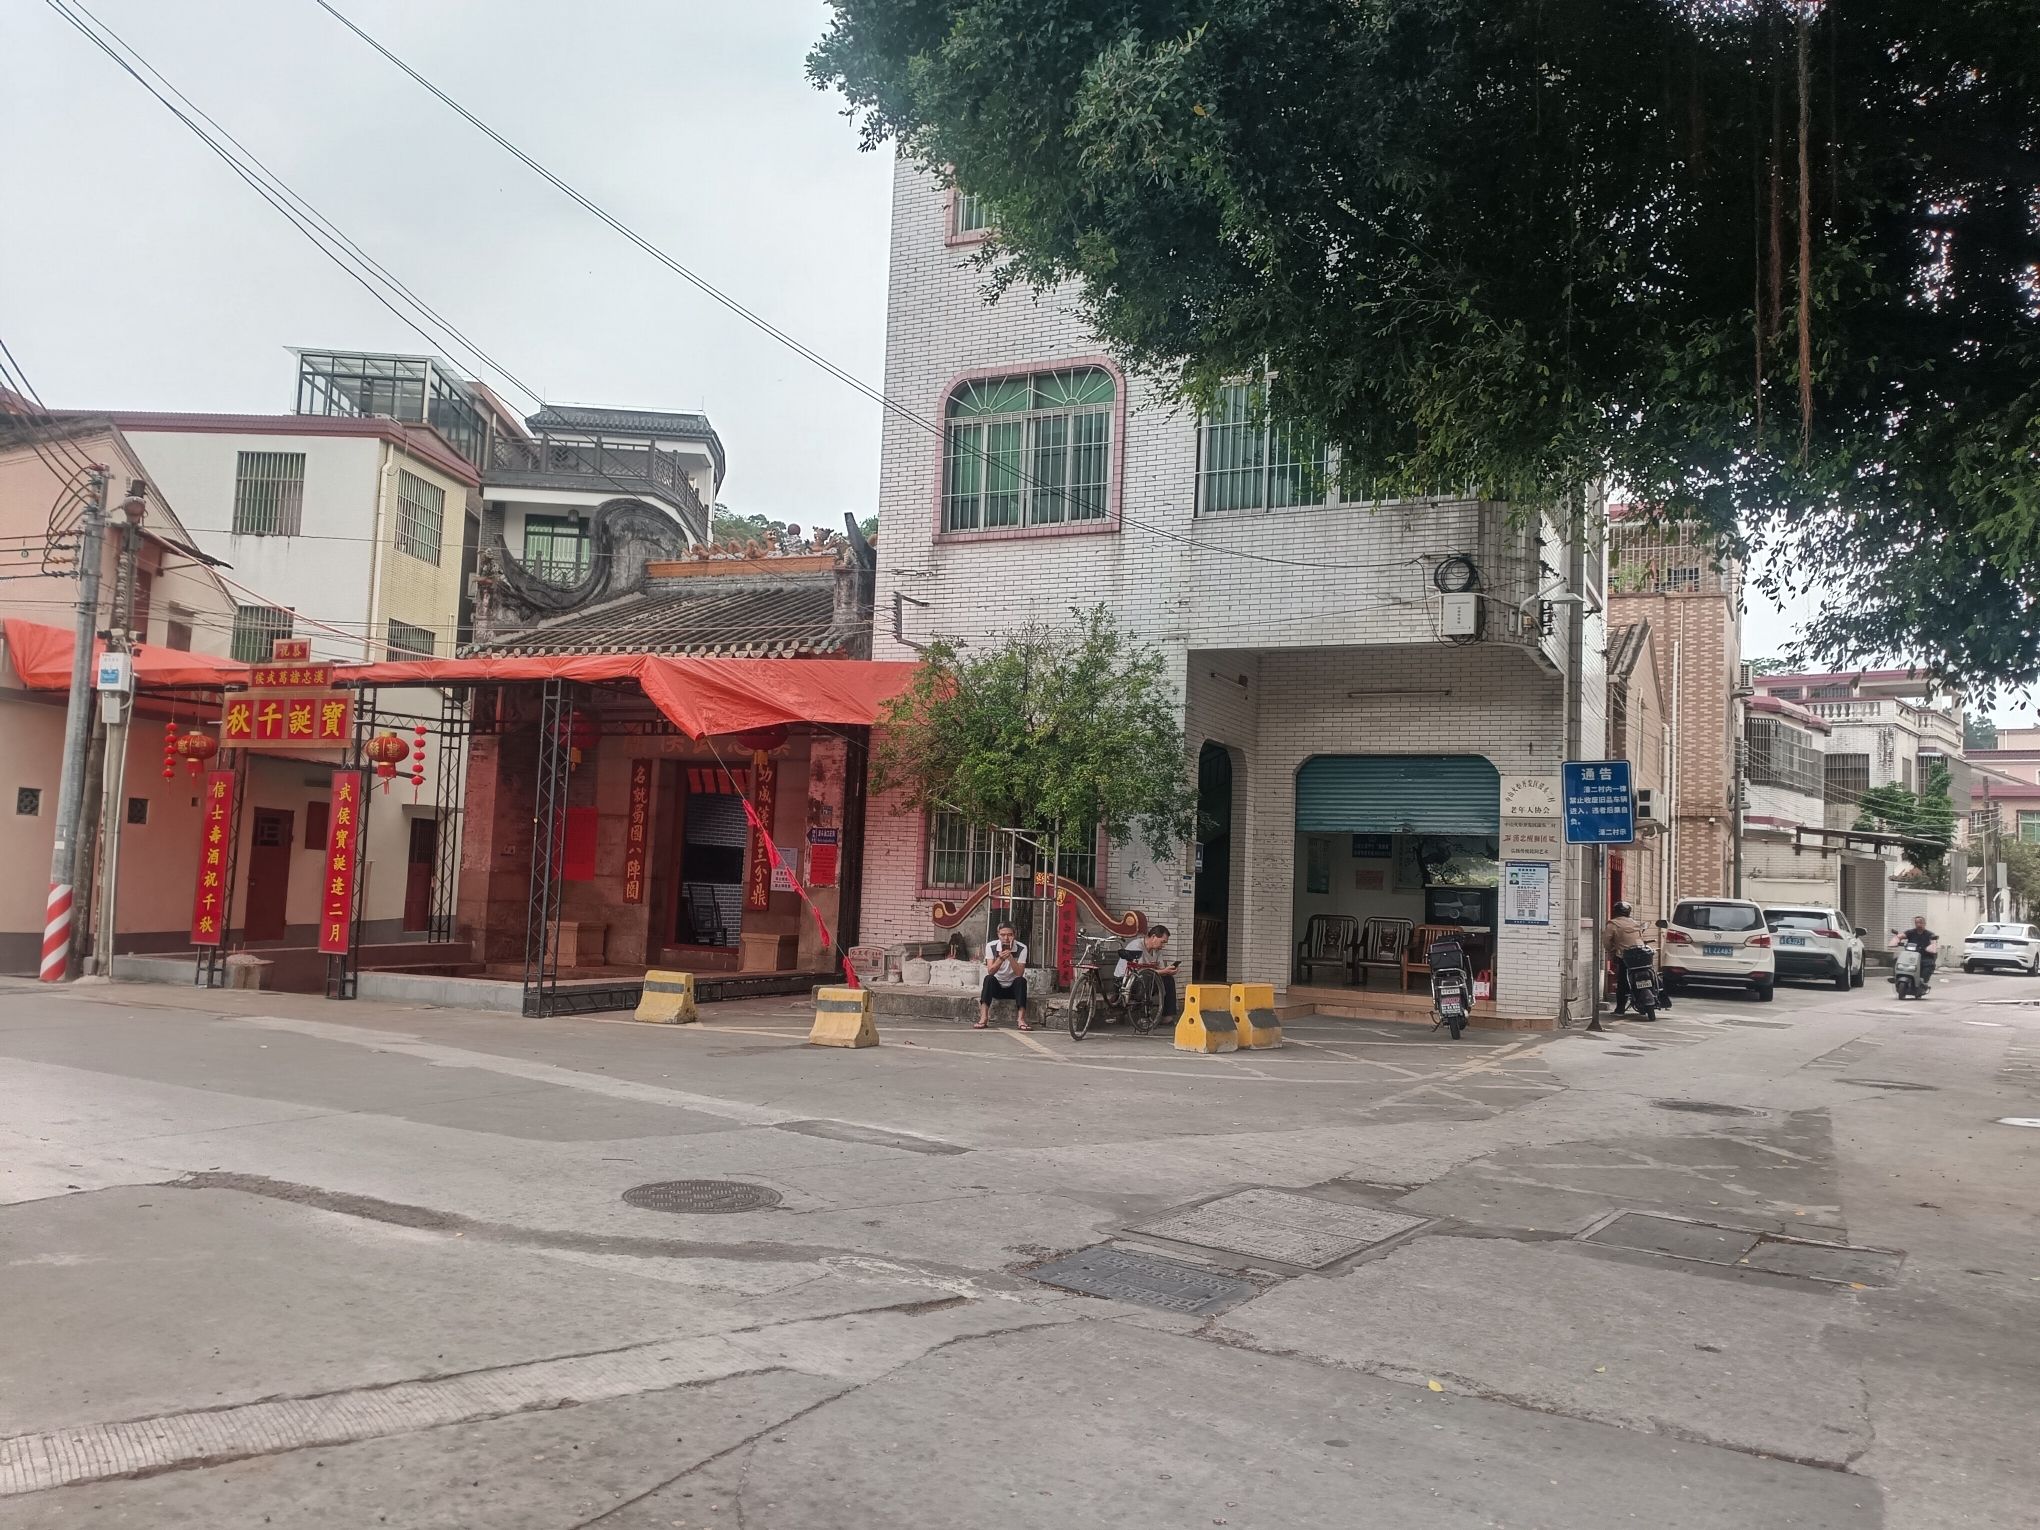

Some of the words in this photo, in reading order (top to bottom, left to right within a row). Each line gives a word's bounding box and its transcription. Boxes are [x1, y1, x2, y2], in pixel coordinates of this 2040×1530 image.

[1511, 806, 1550, 814] 老年人协会
[1581, 768, 1612, 781] 通告
[199, 781, 227, 933] 信士壽酒祝千秋
[328, 783, 354, 942] 武侯寶誕逢二月
